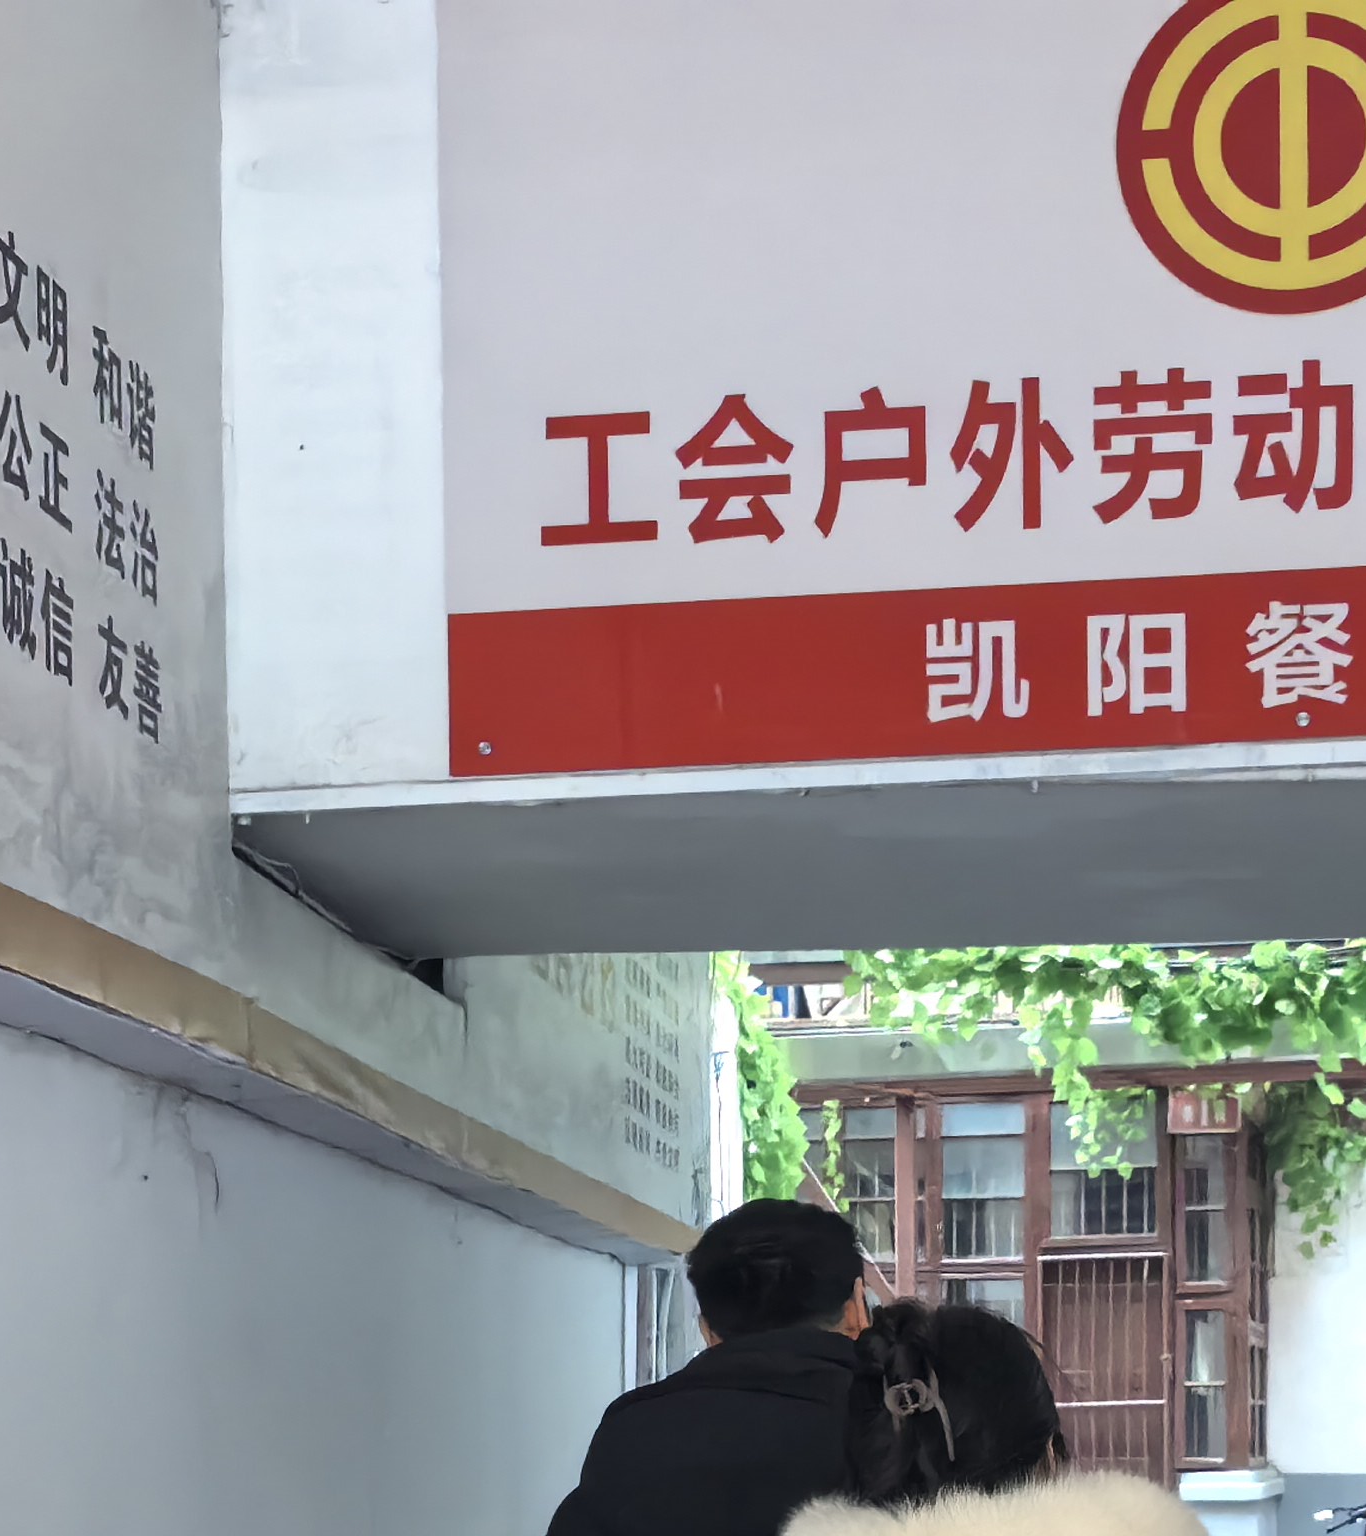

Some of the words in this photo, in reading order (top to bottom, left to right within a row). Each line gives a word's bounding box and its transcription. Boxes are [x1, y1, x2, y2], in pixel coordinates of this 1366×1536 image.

[92, 325, 155, 471] 和谐
[95, 469, 158, 607] 法治
[98, 615, 162, 744] 友善
